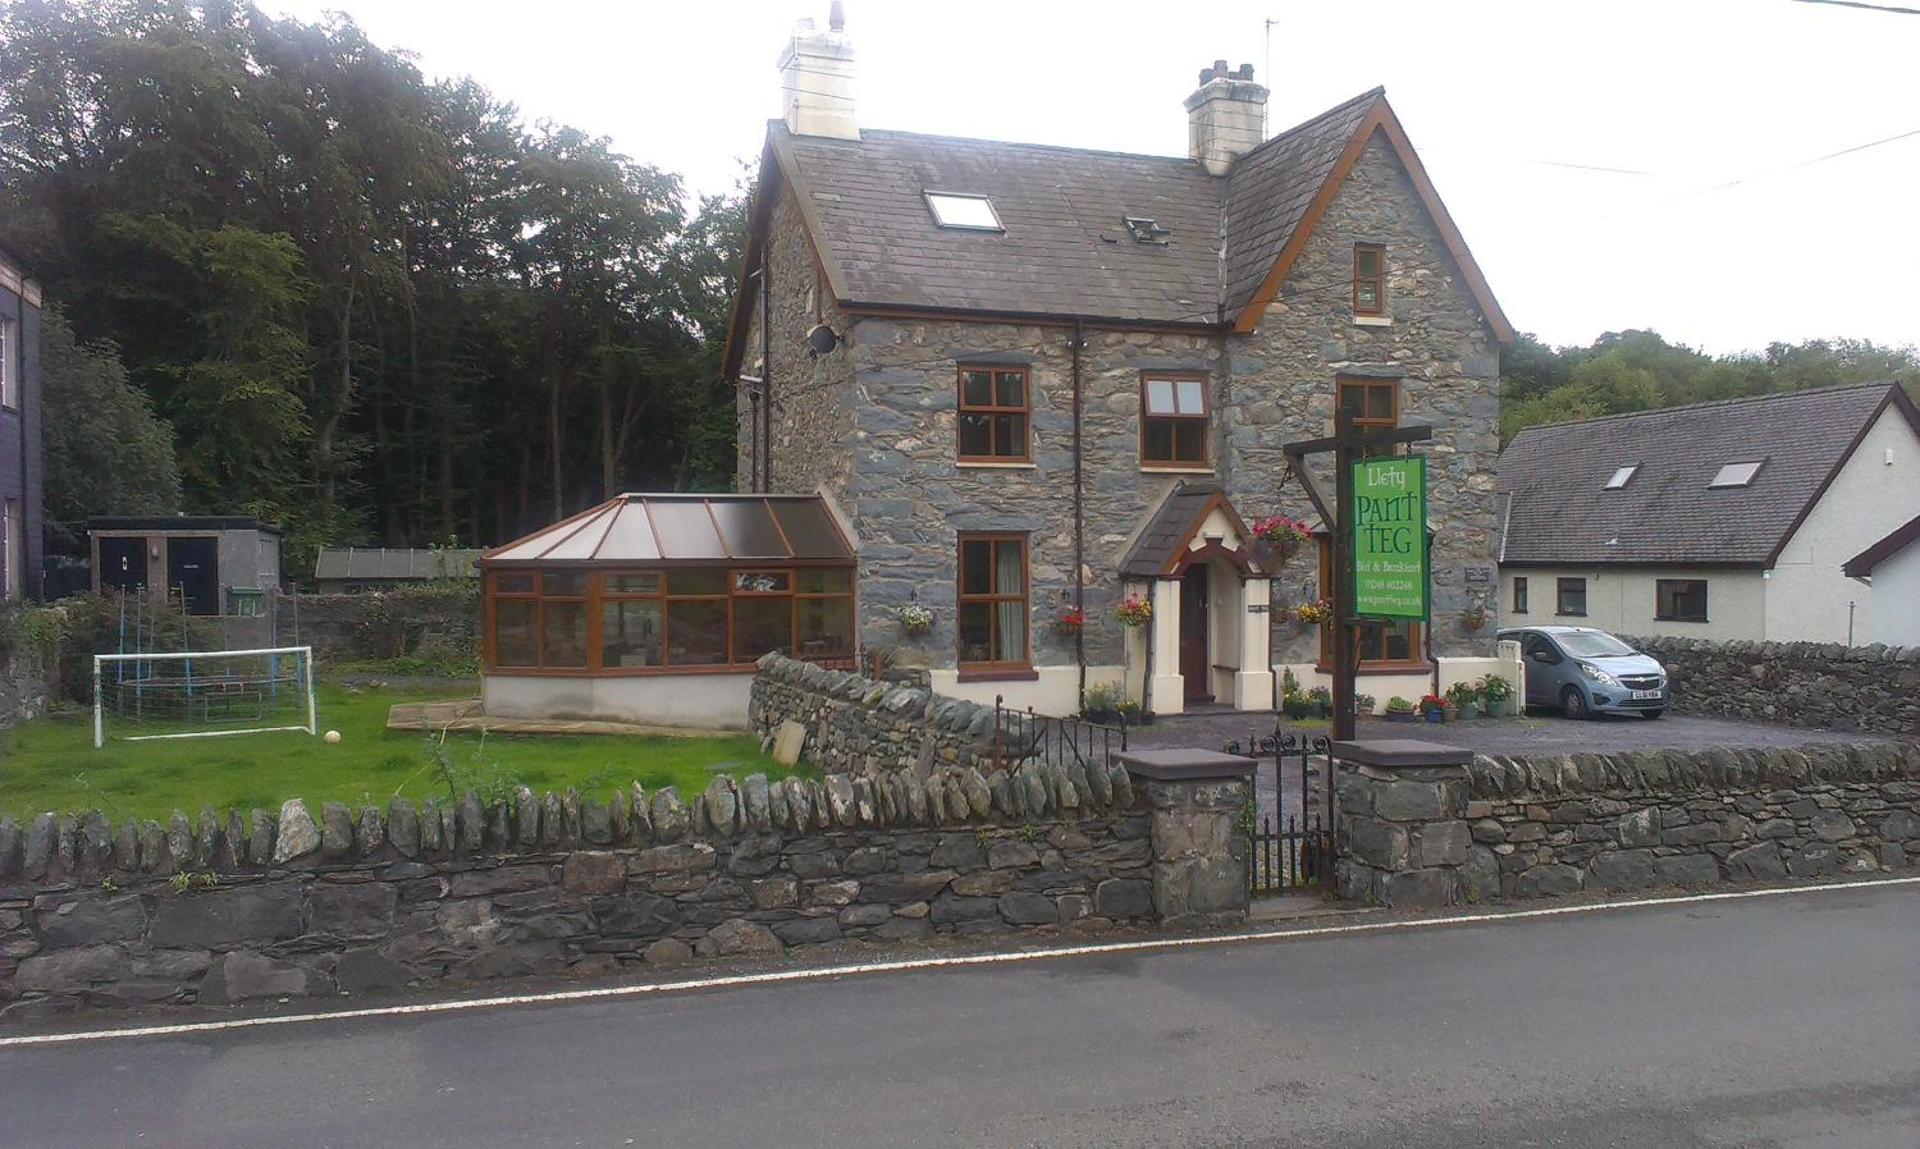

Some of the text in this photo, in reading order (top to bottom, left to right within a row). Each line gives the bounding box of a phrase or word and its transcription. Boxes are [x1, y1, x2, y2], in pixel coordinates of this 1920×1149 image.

[1368, 466, 1405, 490] Llety
[1364, 523, 1412, 554] TEG
[1373, 562, 1382, 572] &
